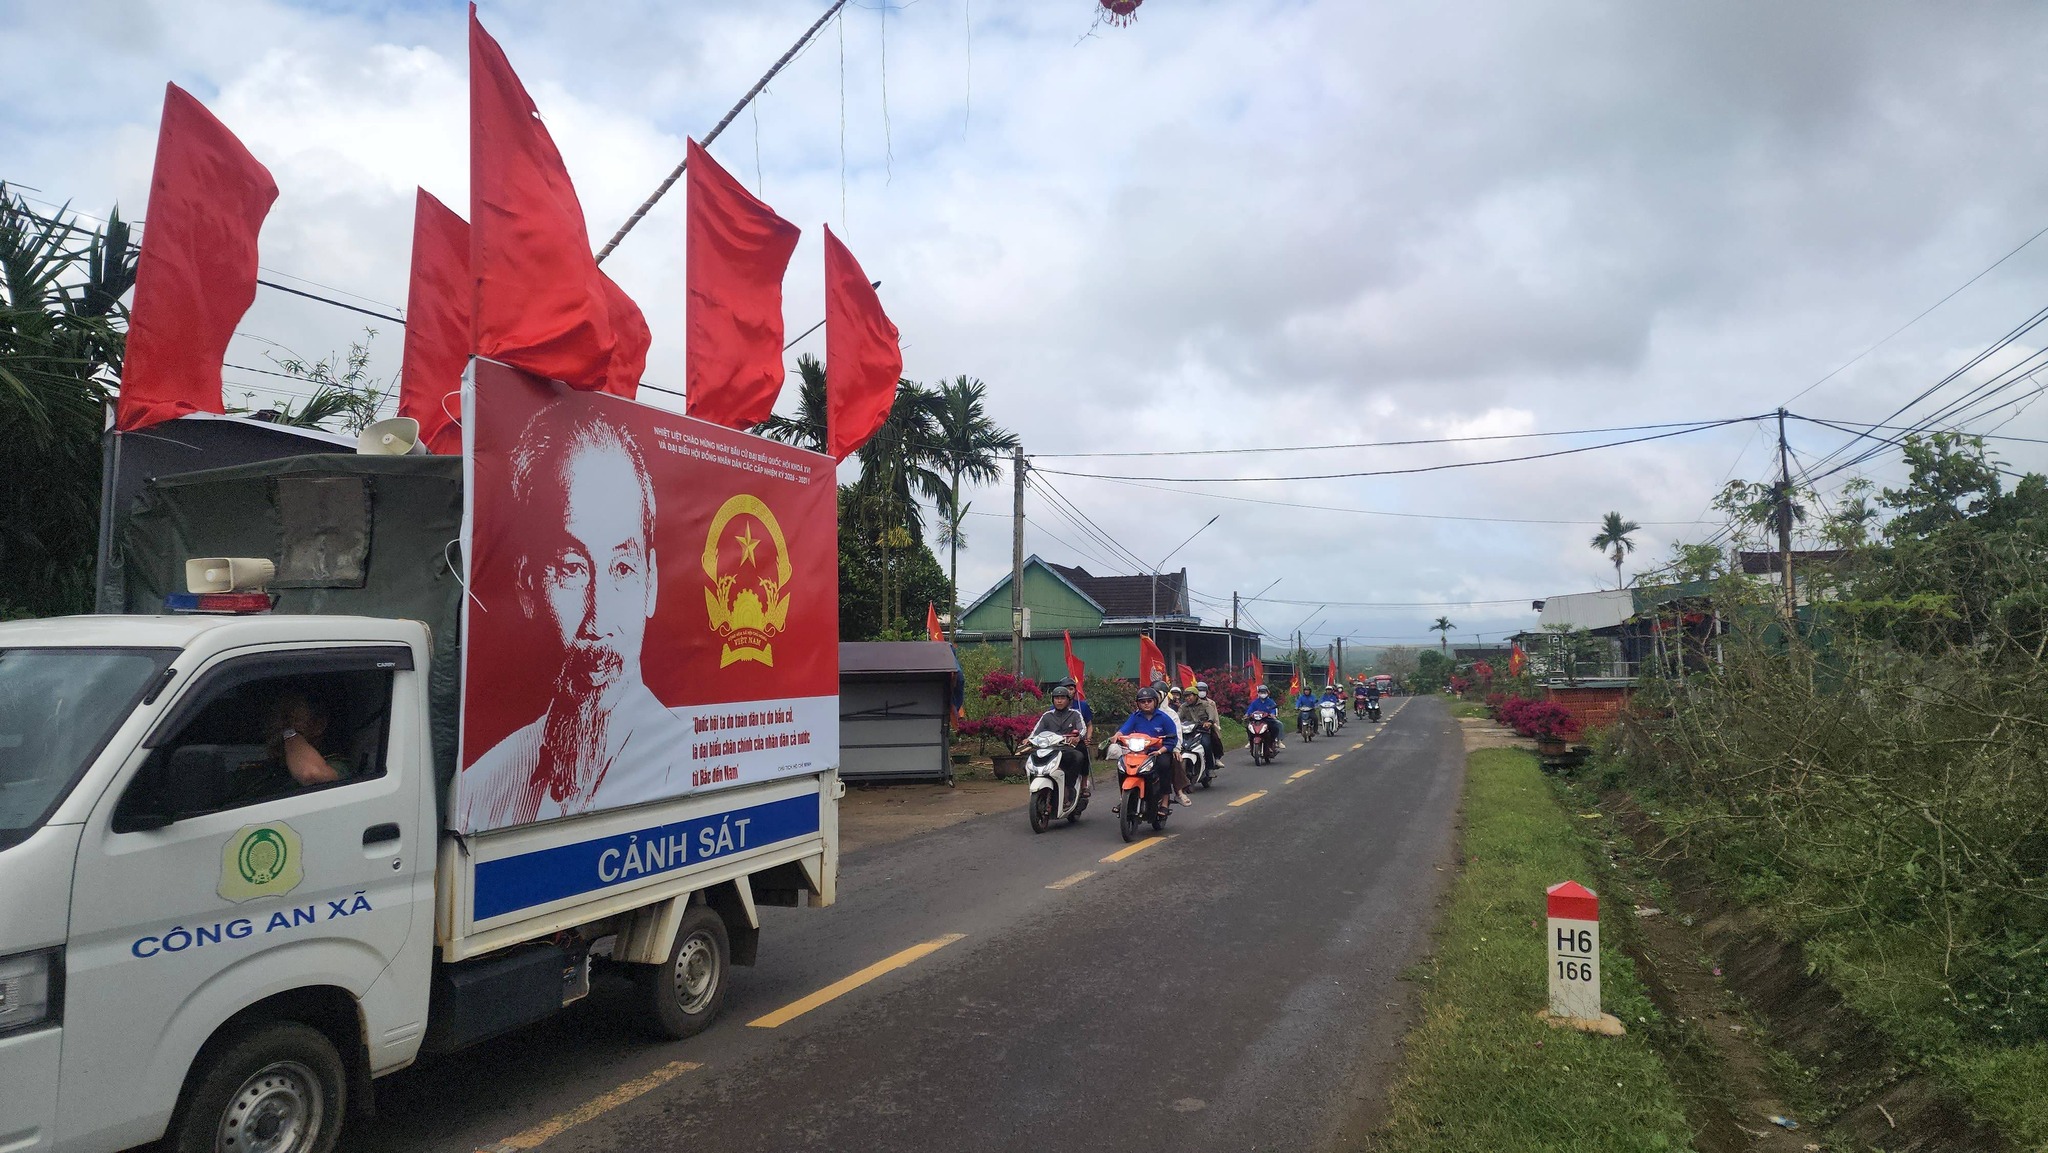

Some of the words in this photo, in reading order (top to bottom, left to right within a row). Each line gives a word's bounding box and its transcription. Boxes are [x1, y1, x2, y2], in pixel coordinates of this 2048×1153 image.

[598, 835, 687, 882] CẢNH
[699, 815, 751, 858] SÁT
[131, 918, 253, 959] CÔNG
[265, 905, 315, 933] AN
[327, 890, 373, 920] XÃ
[1557, 927, 1592, 953] H6
[1557, 960, 1592, 982] 166
